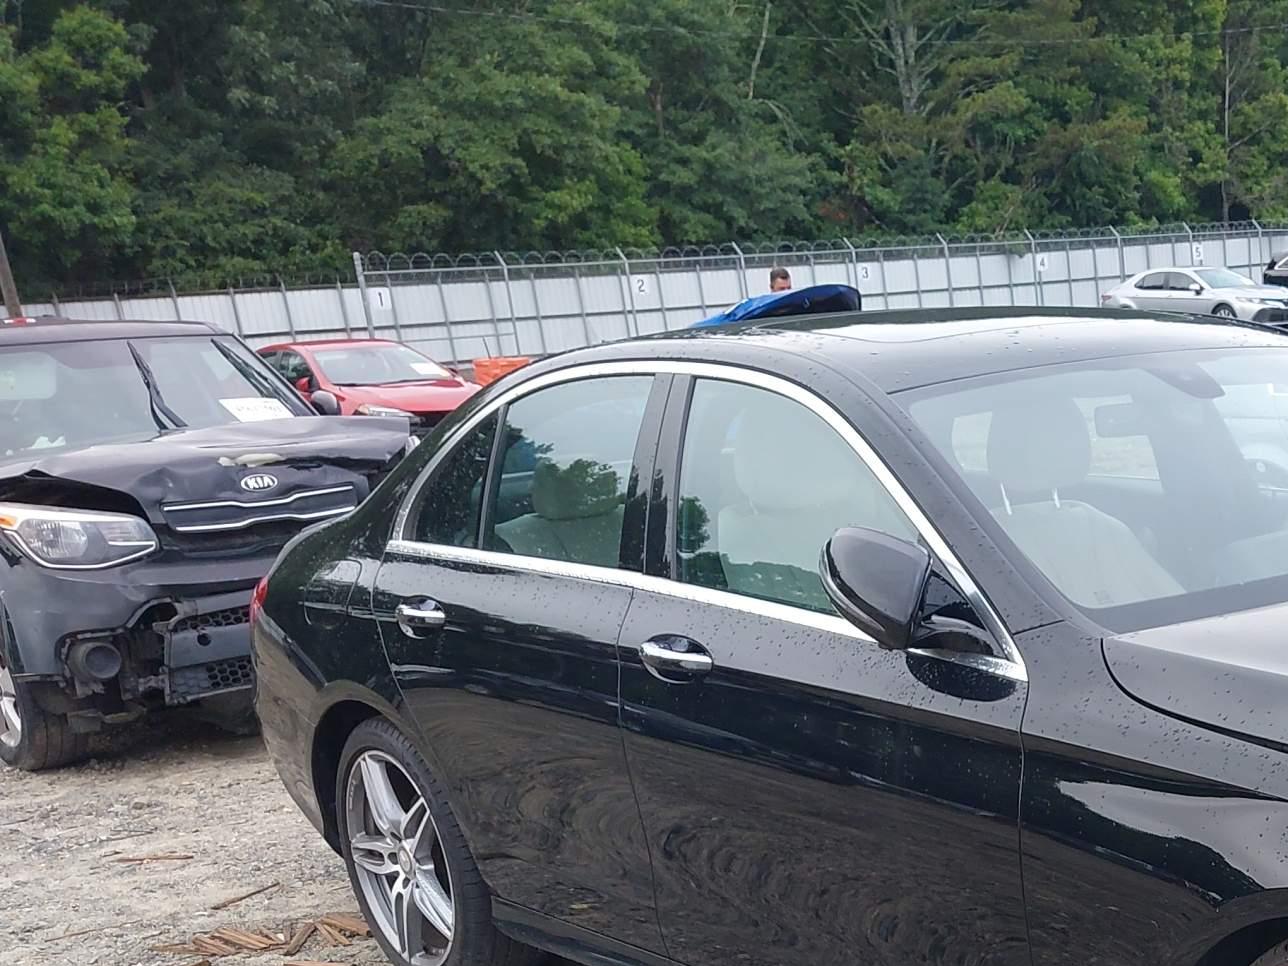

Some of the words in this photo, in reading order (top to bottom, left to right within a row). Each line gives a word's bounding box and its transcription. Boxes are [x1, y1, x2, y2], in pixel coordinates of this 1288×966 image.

[861, 266, 869, 279] 3
[637, 279, 645, 292] 2
[244, 475, 275, 489] KIA
